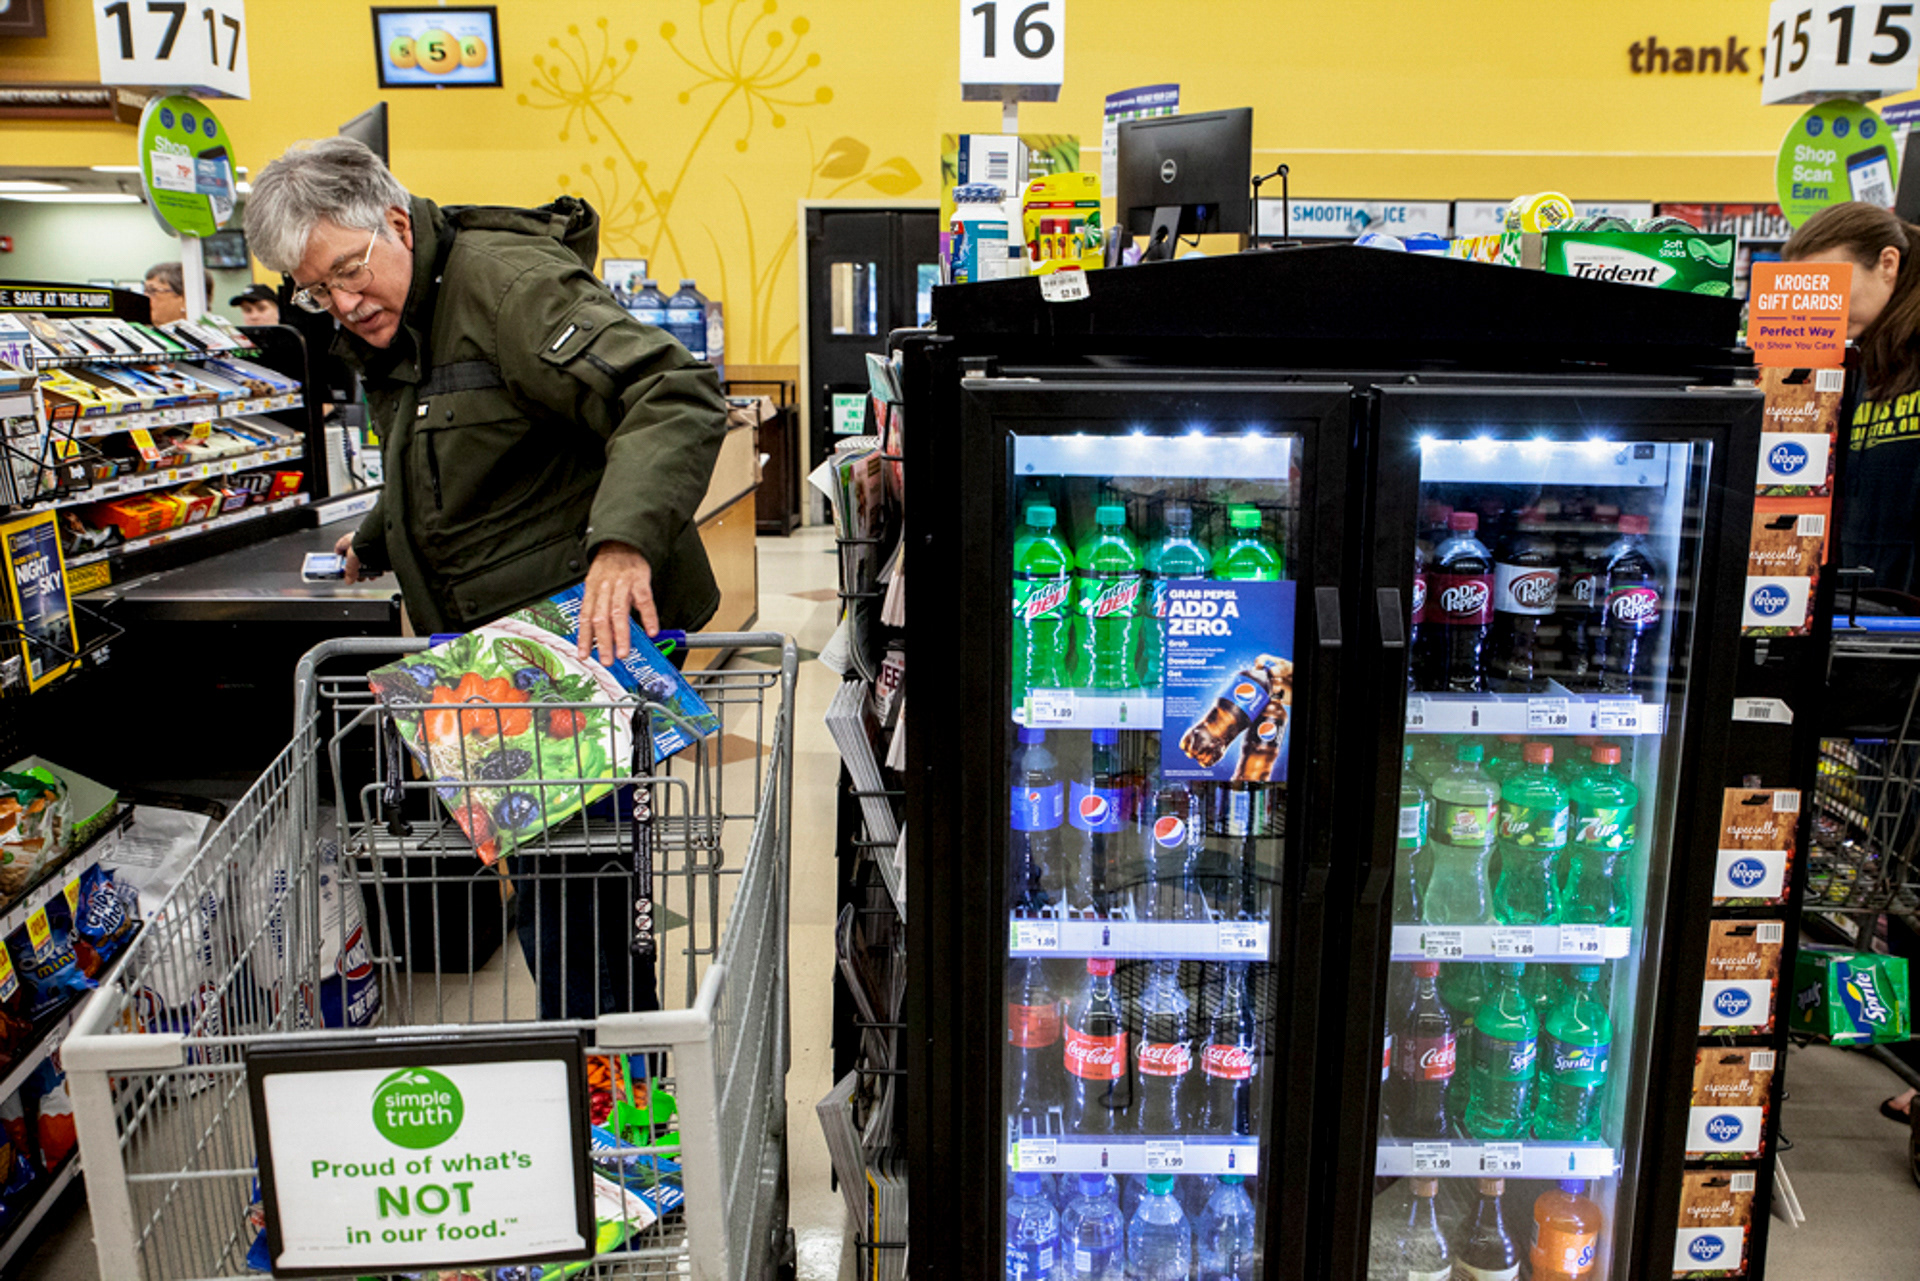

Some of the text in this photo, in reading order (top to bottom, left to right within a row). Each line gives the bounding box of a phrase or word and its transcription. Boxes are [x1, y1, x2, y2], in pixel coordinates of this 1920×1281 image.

[104, 1, 187, 60] 17
[202, 7, 241, 72] 17
[971, 1, 1056, 60] 16
[1828, 4, 1914, 66] 15
[428, 41, 447, 62] 5
[1772, 8, 1813, 79] 15
[1627, 36, 1750, 74] thank
[1292, 205, 1353, 222] SMOOTH
[1383, 206, 1407, 223] ICE
[1659, 248, 1687, 259] Sticks
[1663, 239, 1684, 249] Soft
[1573, 262, 1660, 283] Trident
[1774, 274, 1831, 291] KROGER
[13, 291, 42, 306] SAVE
[44, 292, 58, 306] AT
[59, 292, 80, 307] THE
[1758, 293, 1843, 311] GIFT CARDS!
[1760, 326, 1836, 339] Perfect Way
[1767, 341, 1792, 350] Show
[1794, 341, 1812, 350] You
[1766, 401, 1820, 421] especially
[1771, 446, 1806, 472] Kroger
[1749, 546, 1802, 566] especially
[15, 555, 50, 585] NIGHT
[39, 570, 62, 596] SKY
[1168, 589, 1202, 600] GRAB
[1754, 589, 1788, 614] Kroger
[1168, 600, 1240, 618] ADD A
[1168, 618, 1232, 637] ZERO.
[1726, 820, 1778, 840] especially
[1731, 861, 1764, 885] Kroger
[1710, 951, 1762, 971] especially
[1717, 992, 1749, 1015] Kroger
[1854, 971, 1887, 1024] Sprite
[1704, 1078, 1754, 1098] especially
[384, 1090, 452, 1108] simple
[385, 1104, 453, 1128] truth
[1709, 1118, 1740, 1141] Kroger
[311, 1150, 533, 1179] Proud of what's
[375, 1181, 475, 1220] NOT
[1686, 1200, 1735, 1219] especially
[346, 1225, 372, 1245] in
[380, 1226, 428, 1244] our
[1691, 1238, 1721, 1260] Kroger
